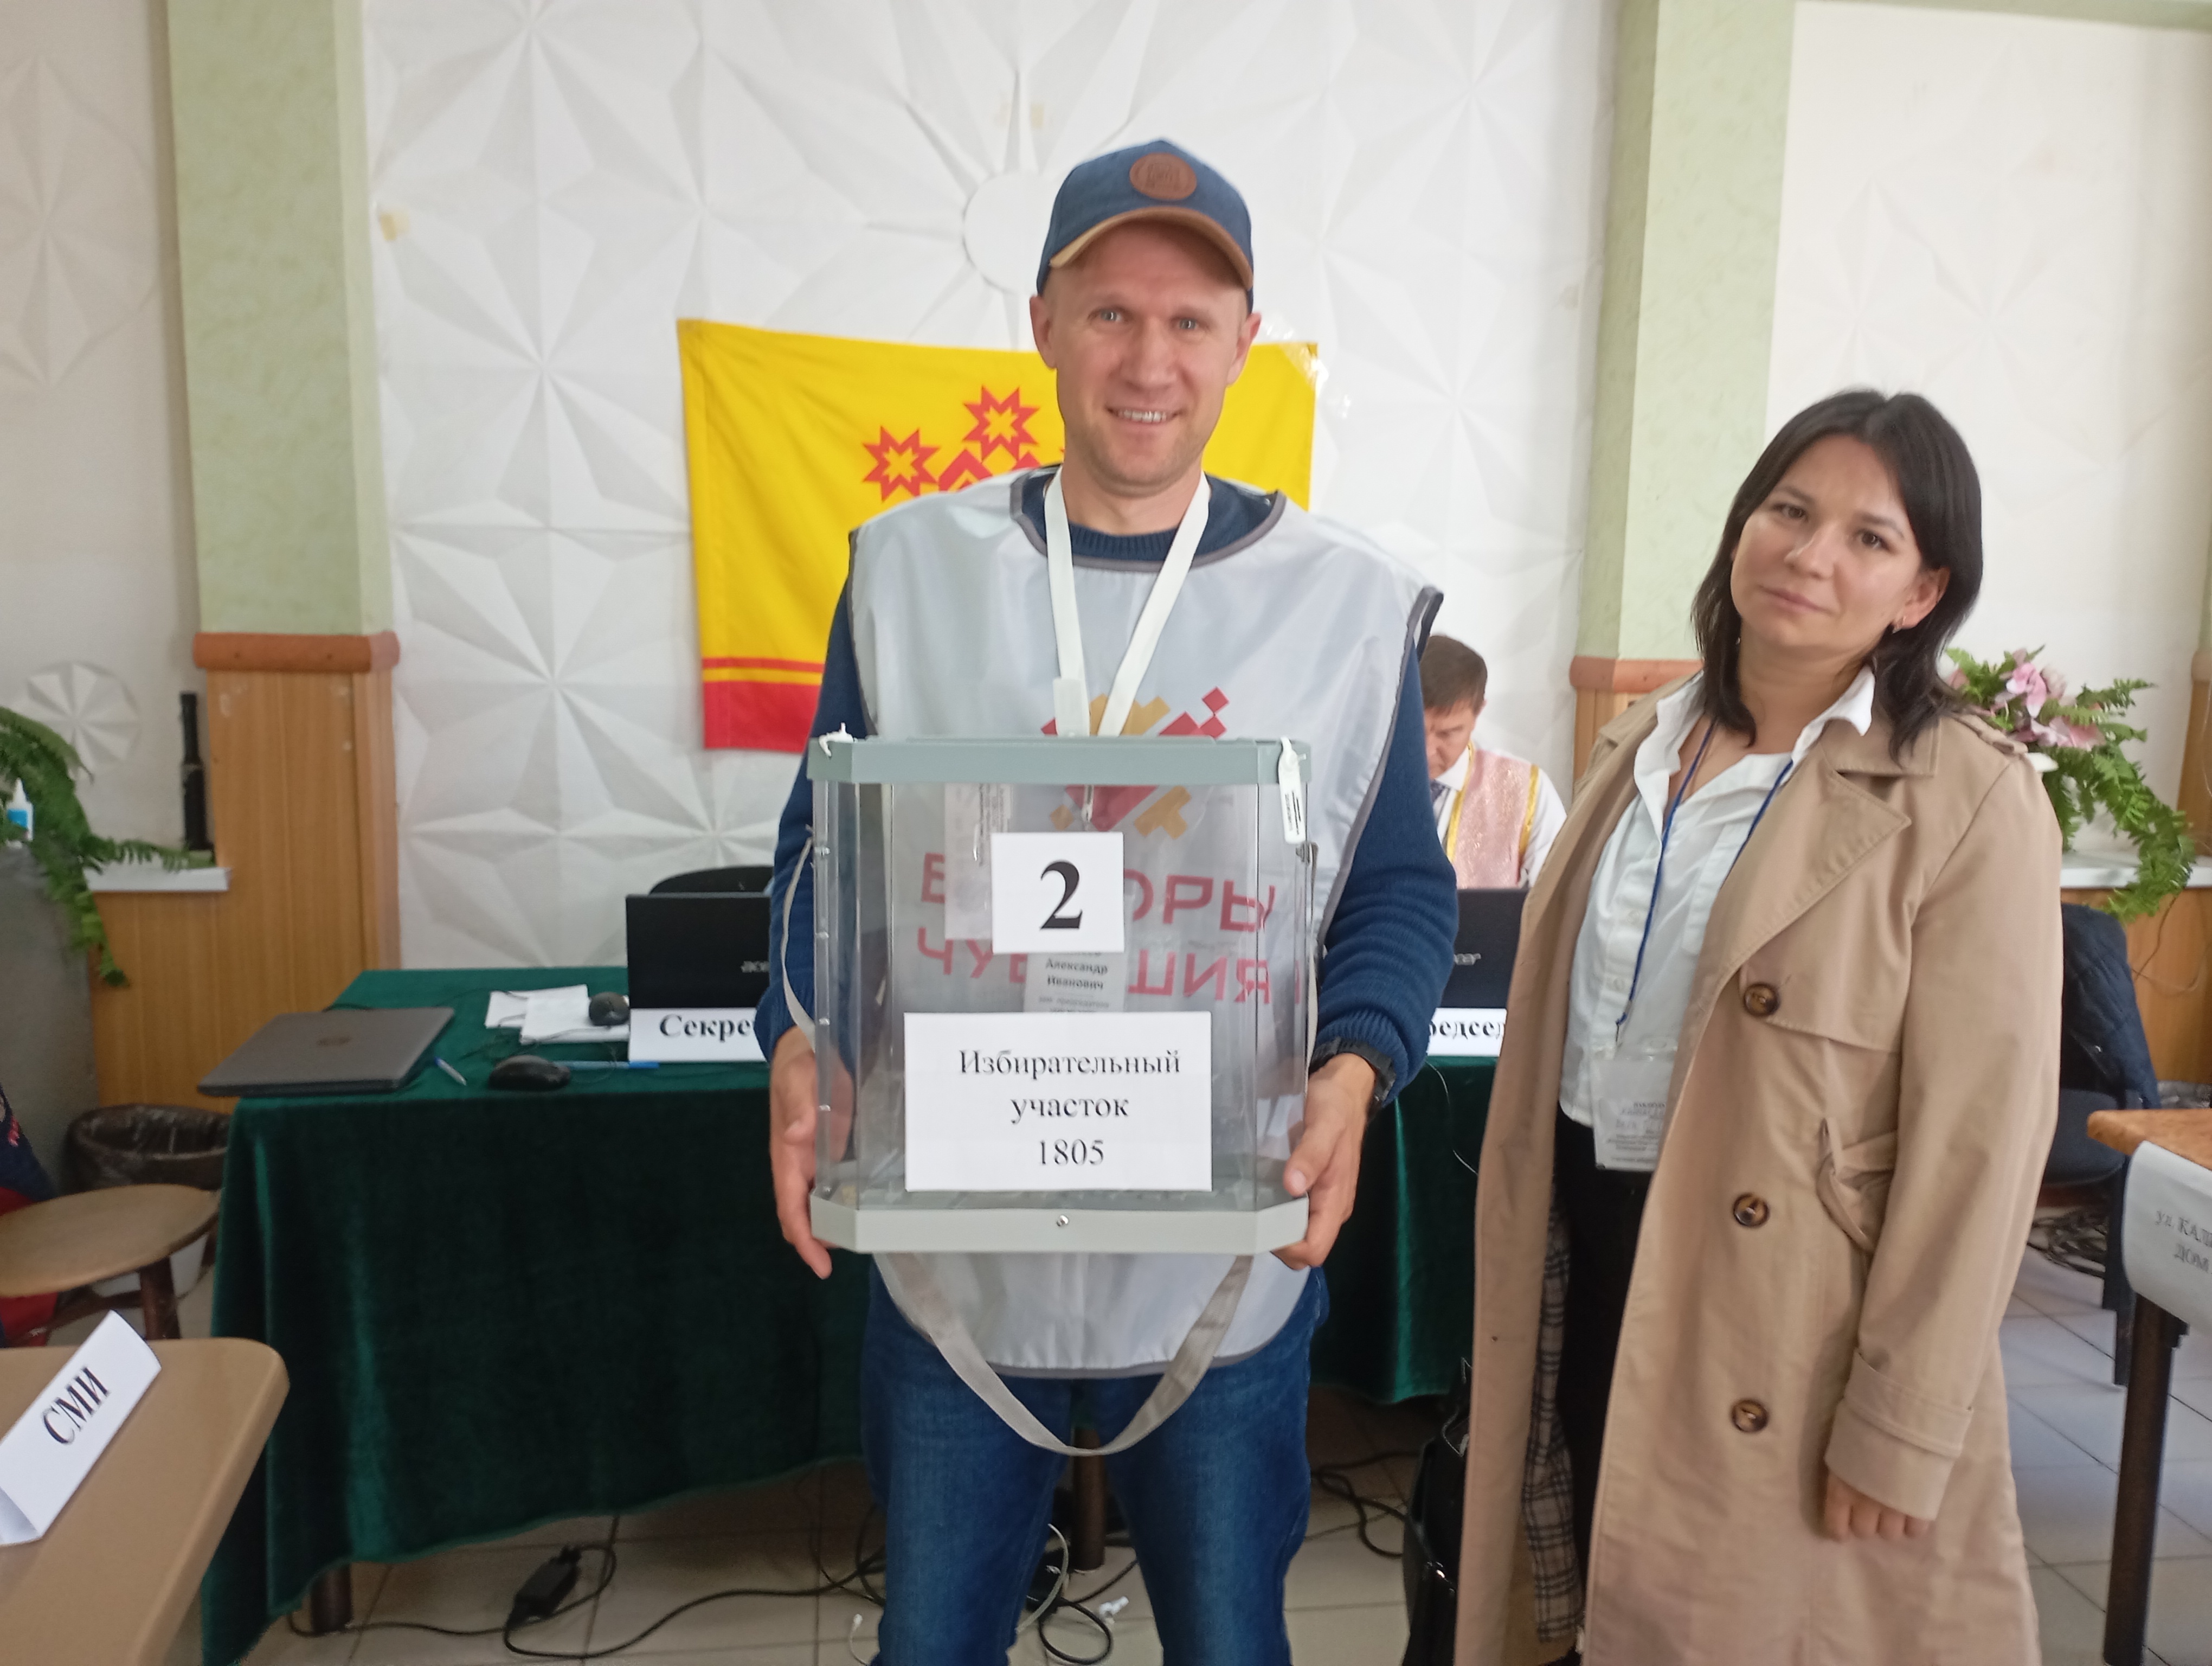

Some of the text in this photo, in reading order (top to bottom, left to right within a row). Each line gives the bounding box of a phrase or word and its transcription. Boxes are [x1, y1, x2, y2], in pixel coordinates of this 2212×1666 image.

[921, 852, 1276, 933] ВОРЫ
[1039, 860, 1083, 930] 2
[1045, 958, 1108, 975] Александр
[1047, 975, 1104, 990] Иванович
[959, 1049, 1181, 1080] Избирательный
[1010, 1095, 1129, 1124] участок
[1039, 1139, 1104, 1166] 1805
[41, 1366, 111, 1445] СМИ
